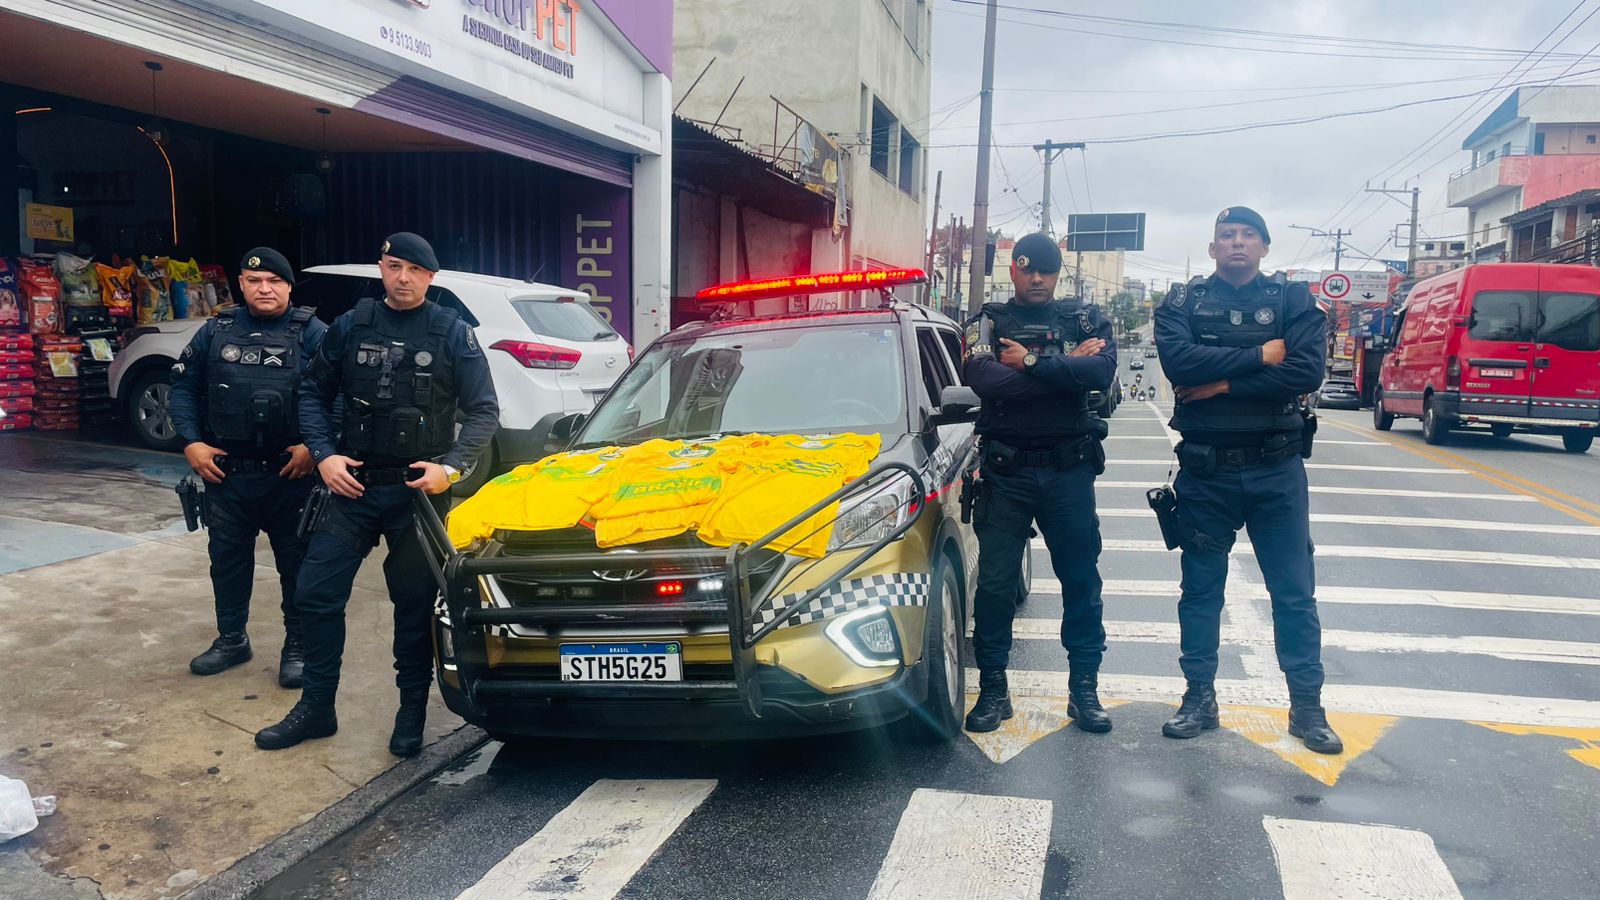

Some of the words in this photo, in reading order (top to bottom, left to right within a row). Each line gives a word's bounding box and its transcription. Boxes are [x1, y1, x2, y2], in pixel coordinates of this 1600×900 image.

[389, 27, 394, 43] 9
[462, 14, 469, 33] A
[469, 17, 503, 48] SEGUNDA
[503, 33, 521, 56] CASA
[530, 46, 543, 66] SEU
[542, 52, 563, 76] AMIGO
[563, 61, 574, 80] PET
[570, 656, 667, 680] STH5G25
